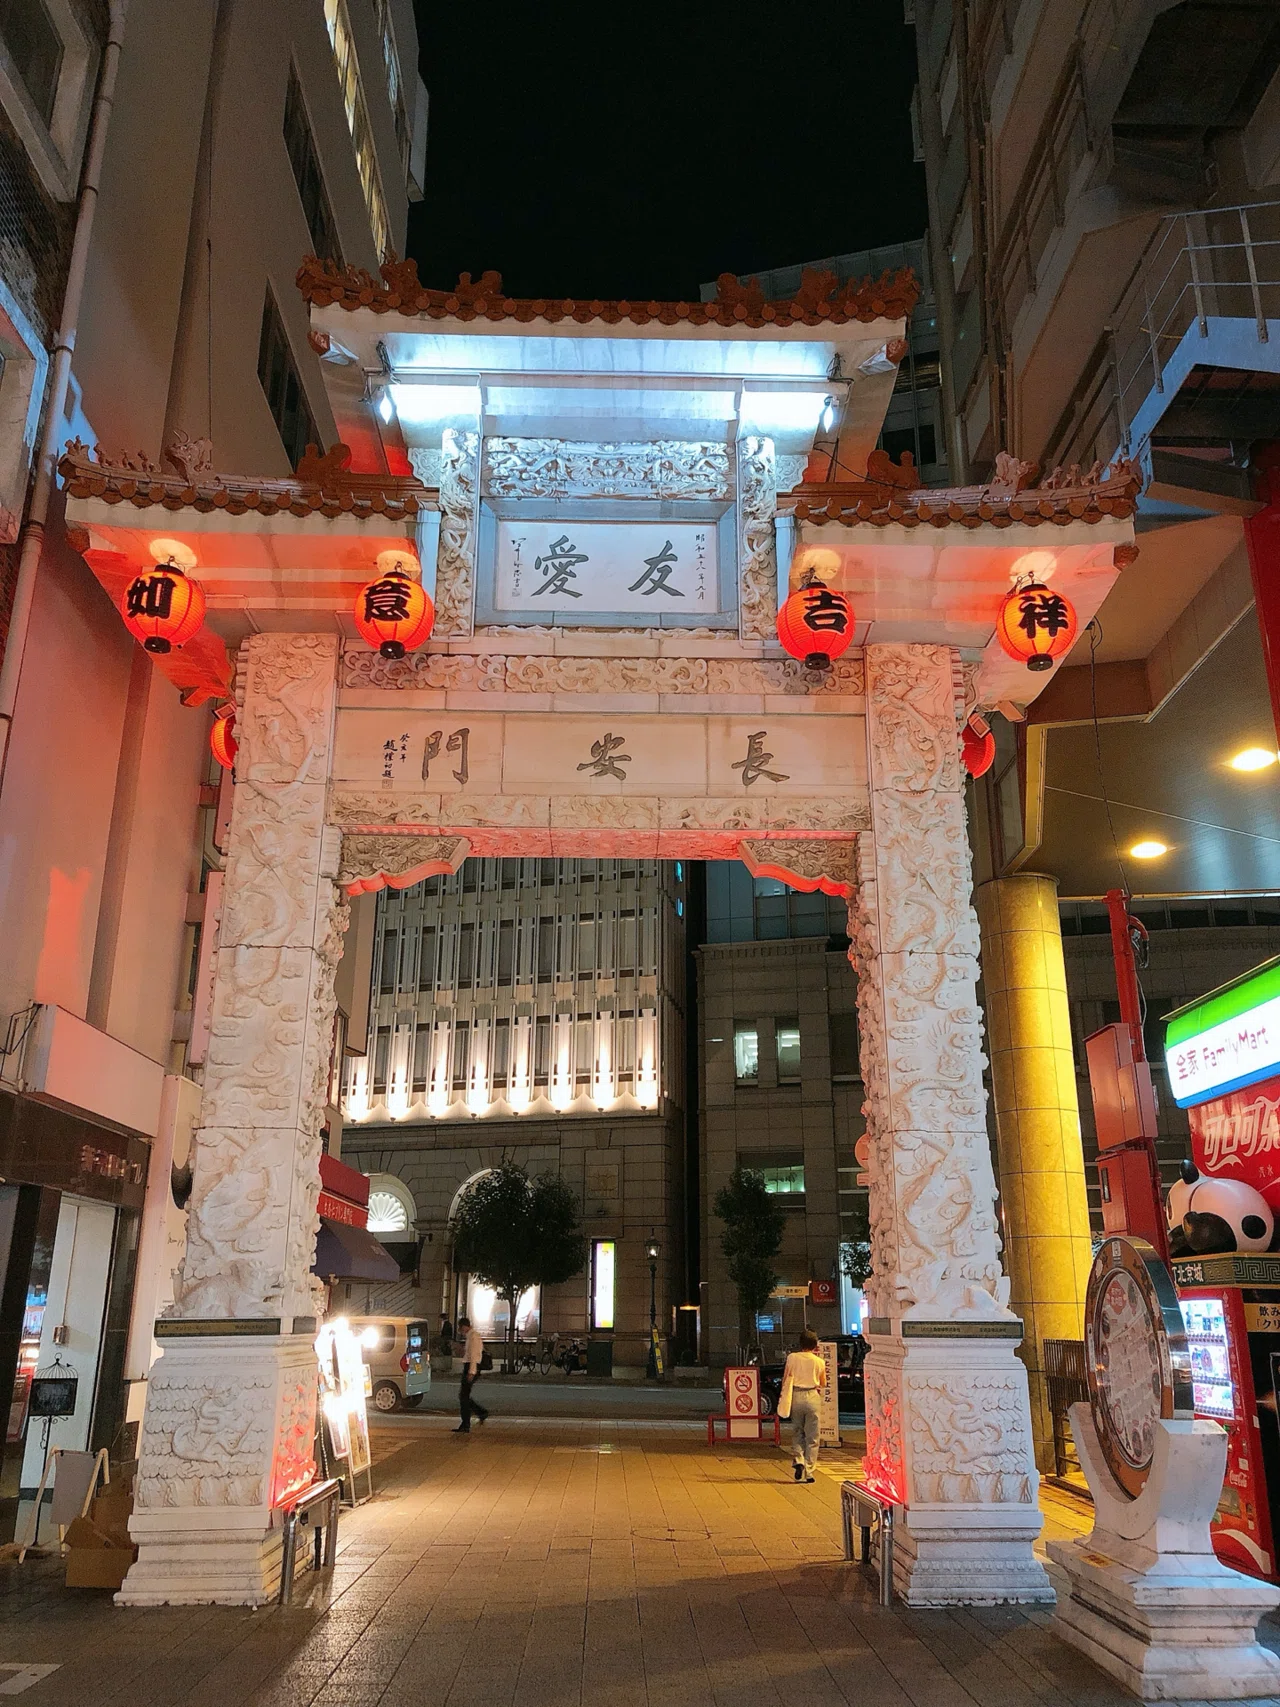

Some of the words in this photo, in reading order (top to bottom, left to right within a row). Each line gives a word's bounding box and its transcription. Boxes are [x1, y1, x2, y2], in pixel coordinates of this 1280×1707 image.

[127, 576, 176, 619] 如
[364, 580, 411, 622] 意
[803, 590, 847, 633] 吉
[1018, 594, 1069, 639] 祥
[1176, 1049, 1199, 1080] 全家
[1202, 1025, 1269, 1070] FamilyMart
